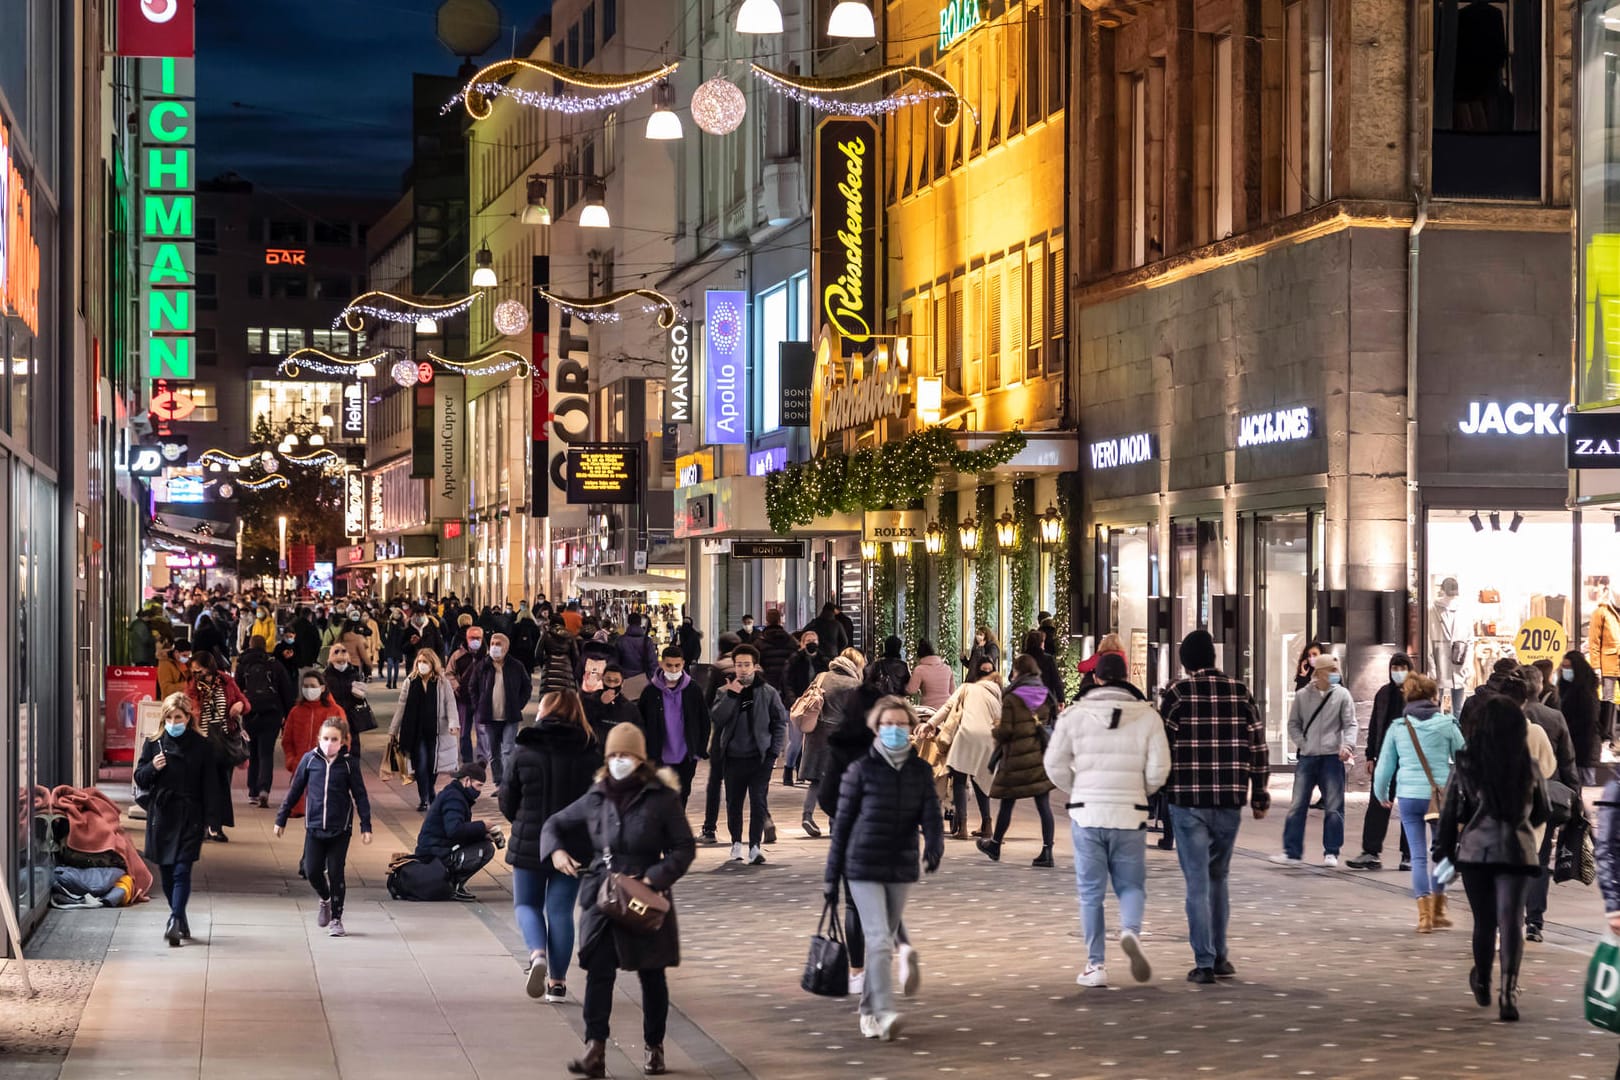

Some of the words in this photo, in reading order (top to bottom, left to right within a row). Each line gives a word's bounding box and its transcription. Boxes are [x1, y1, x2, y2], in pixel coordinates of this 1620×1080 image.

[939, 0, 981, 50] ROLEX
[265, 248, 306, 265] DAK
[671, 325, 688, 420] MANGO
[716, 364, 739, 433] Apollo
[132, 450, 161, 471] JD
[1091, 440, 1117, 469] VERO
[1120, 433, 1151, 465] MODA
[874, 527, 917, 537] ROLEX
[1520, 629, 1560, 652] 20%
